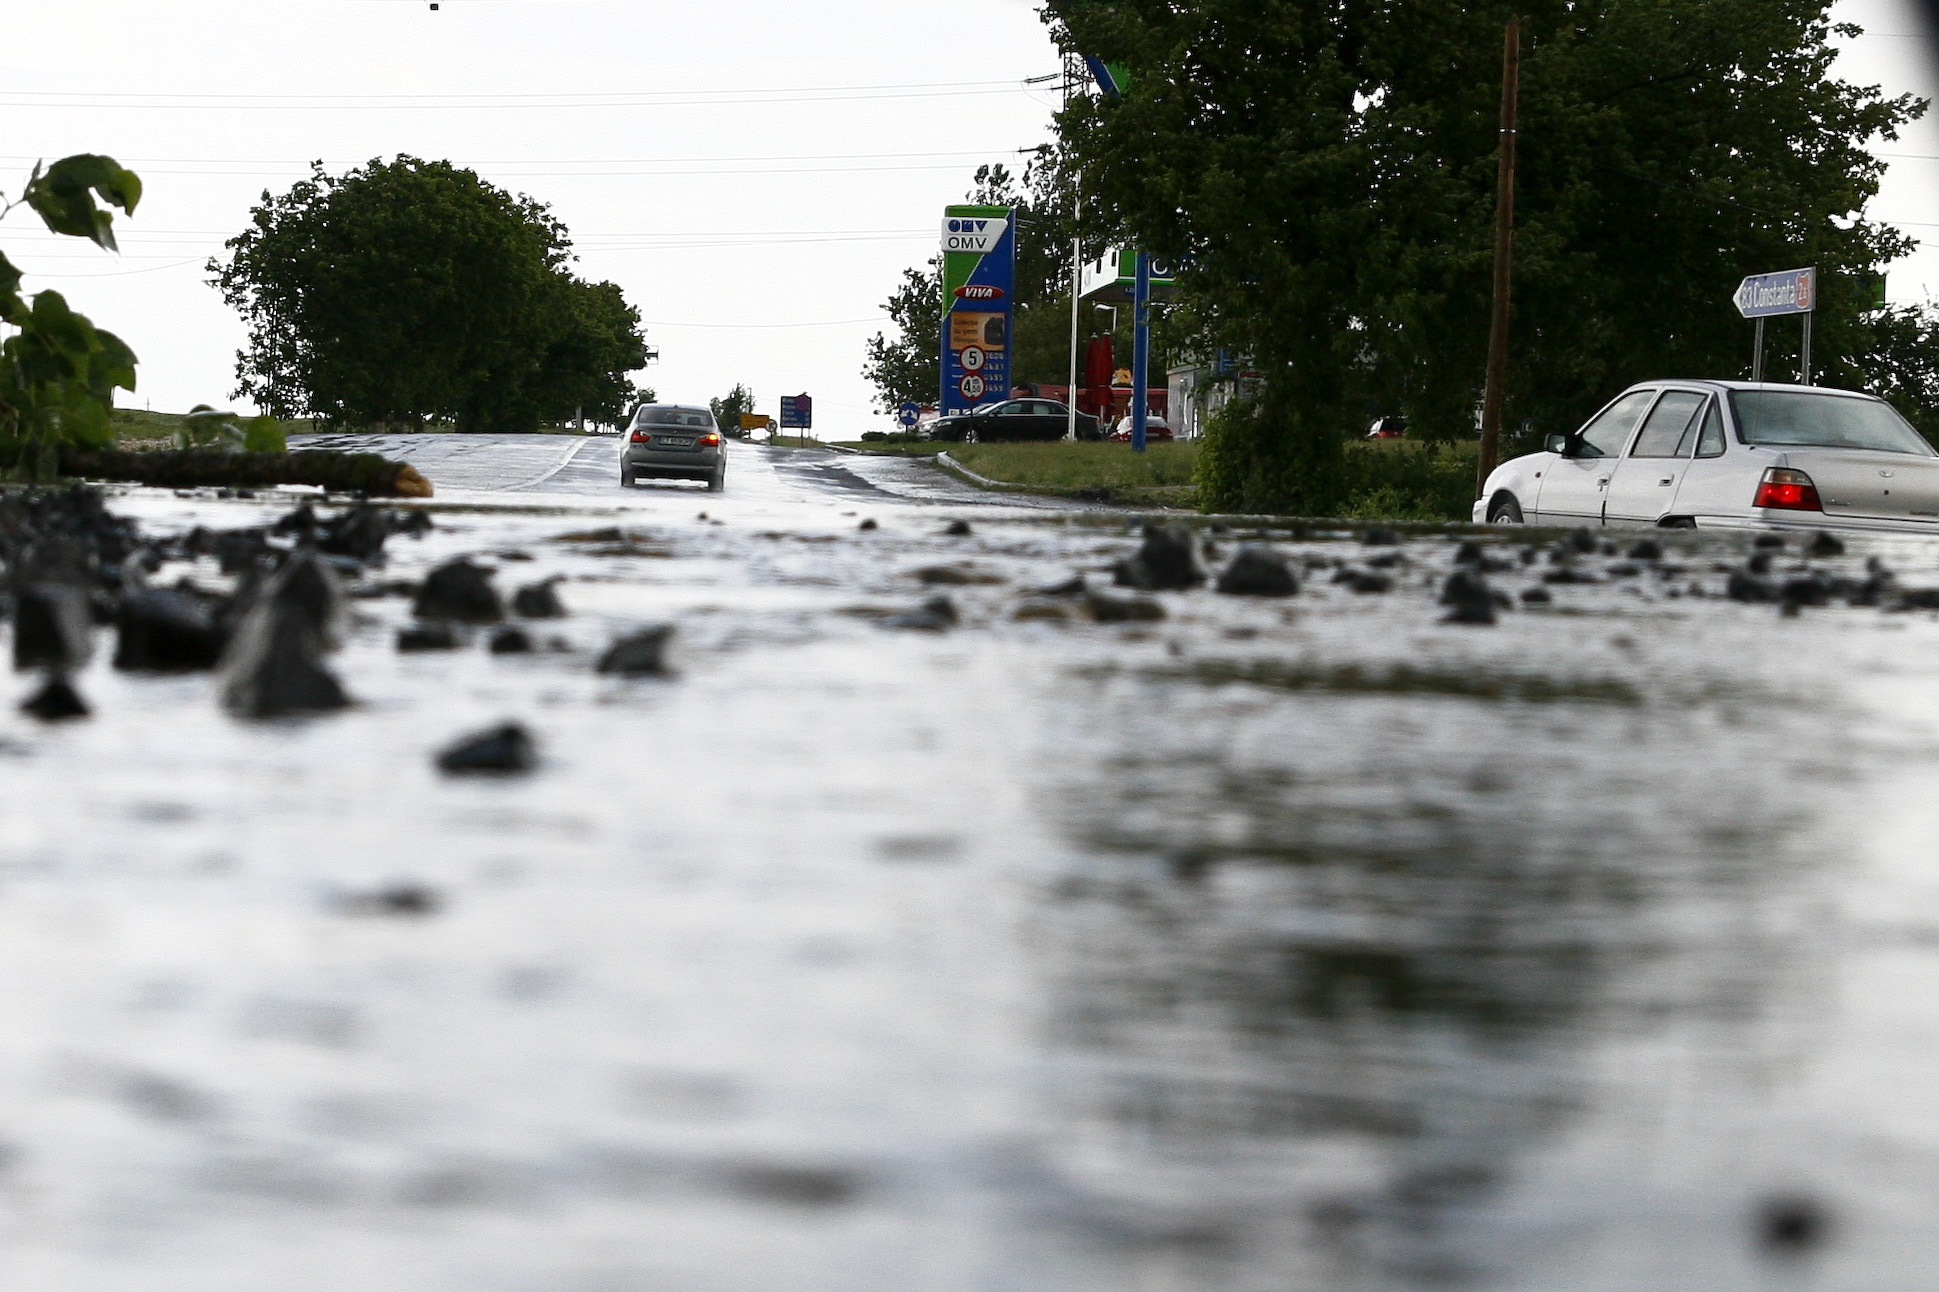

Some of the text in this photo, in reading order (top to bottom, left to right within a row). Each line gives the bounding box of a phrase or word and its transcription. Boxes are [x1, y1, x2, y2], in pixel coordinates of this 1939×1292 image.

[948, 236, 987, 249] OMV
[965, 287, 994, 298] VIVA
[968, 351, 977, 366] 5
